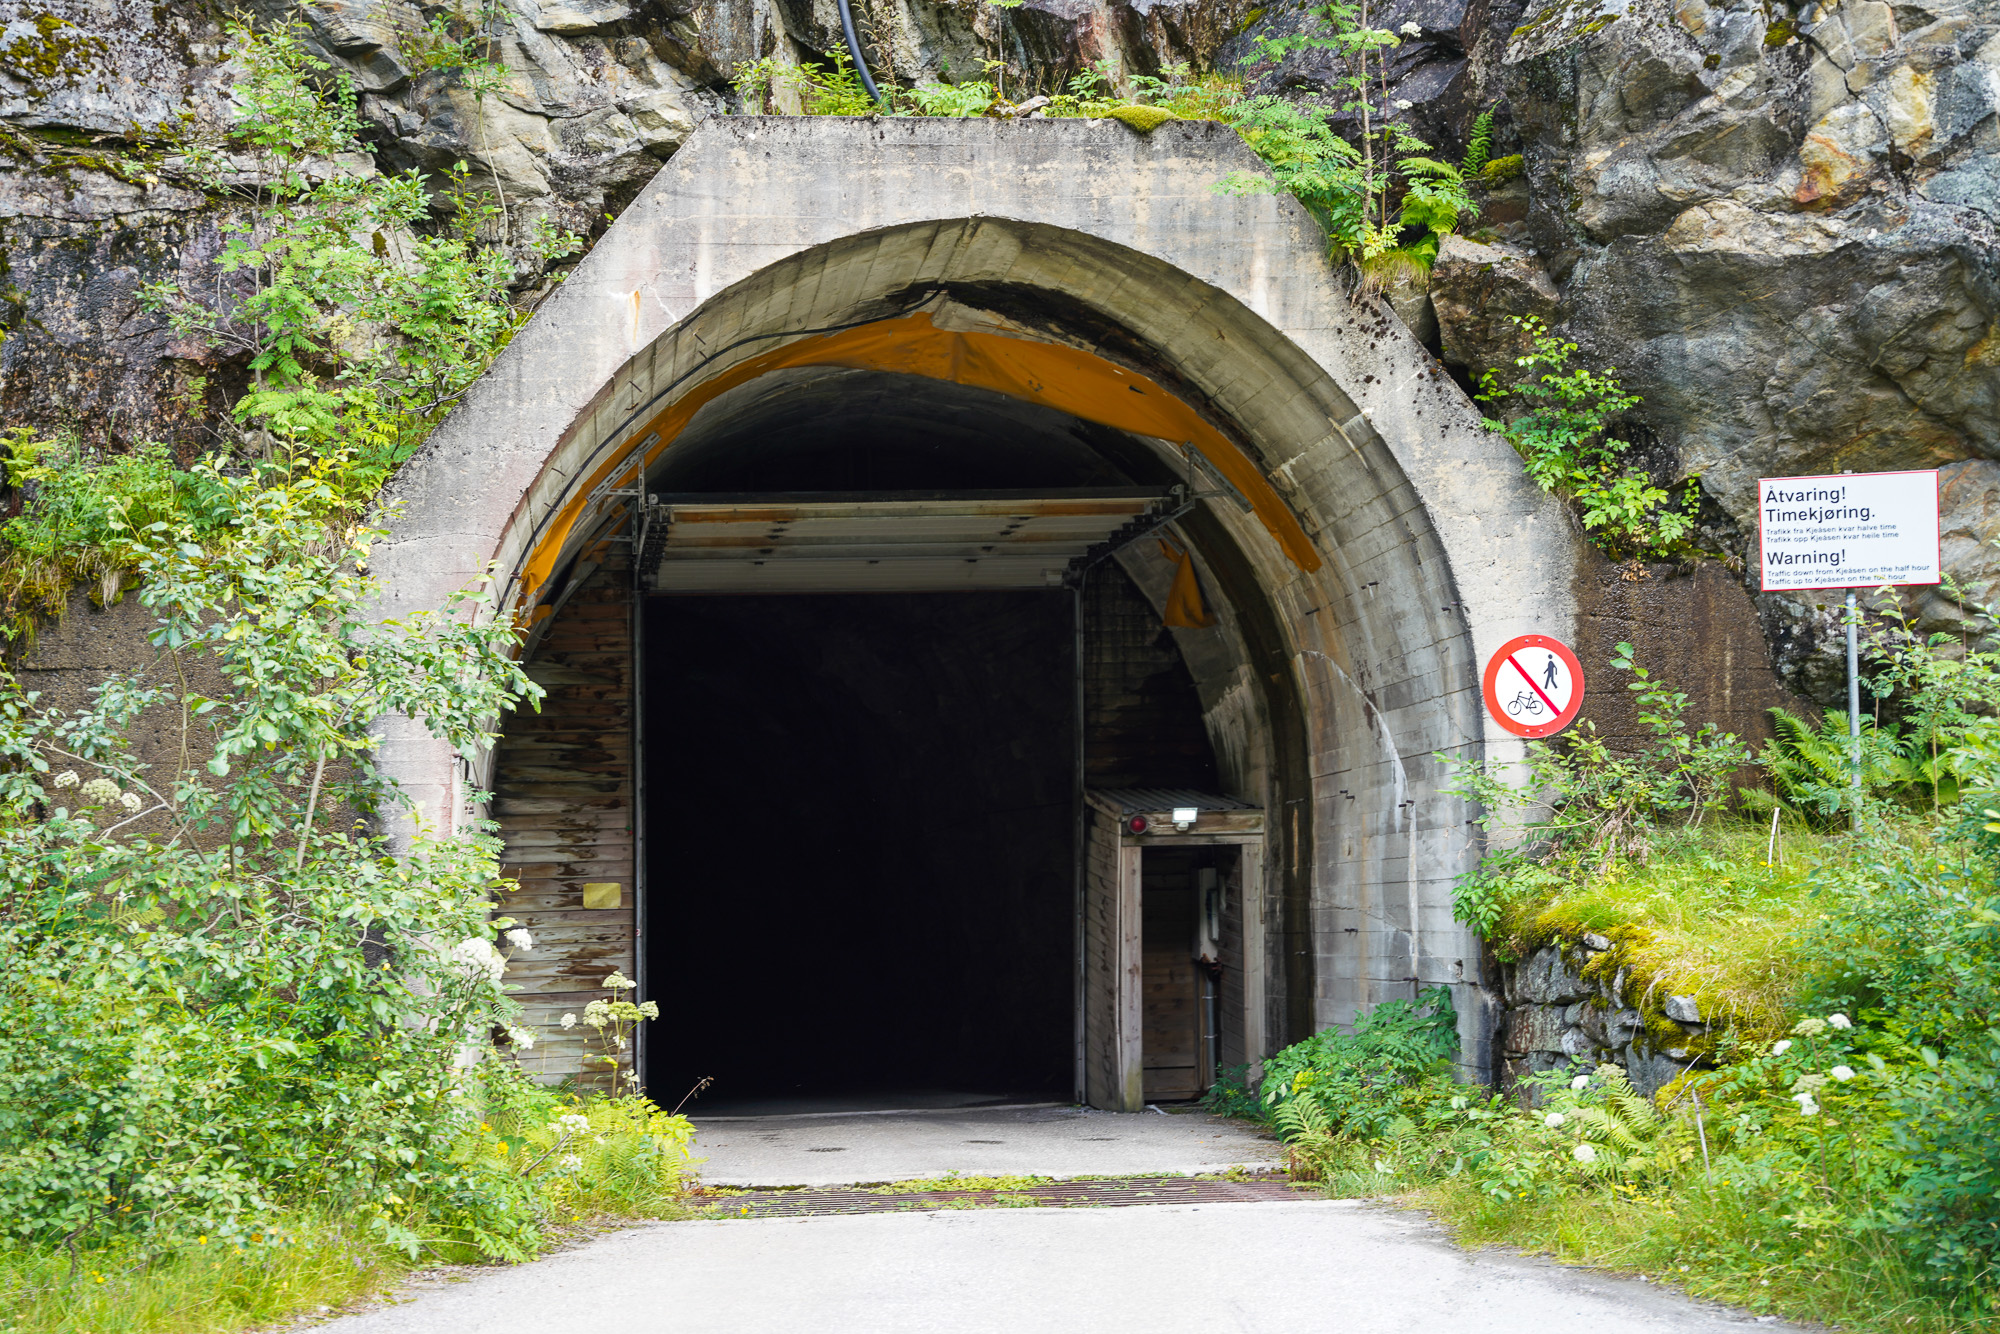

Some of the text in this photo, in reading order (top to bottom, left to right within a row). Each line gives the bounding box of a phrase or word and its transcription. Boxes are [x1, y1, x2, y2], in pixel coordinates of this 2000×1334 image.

[1765, 485, 1846, 504] Åtvaring!
[1765, 506, 1875, 523] Timekjøring.
[1767, 548, 1846, 566] Warning!
[1895, 564, 1910, 572] half
